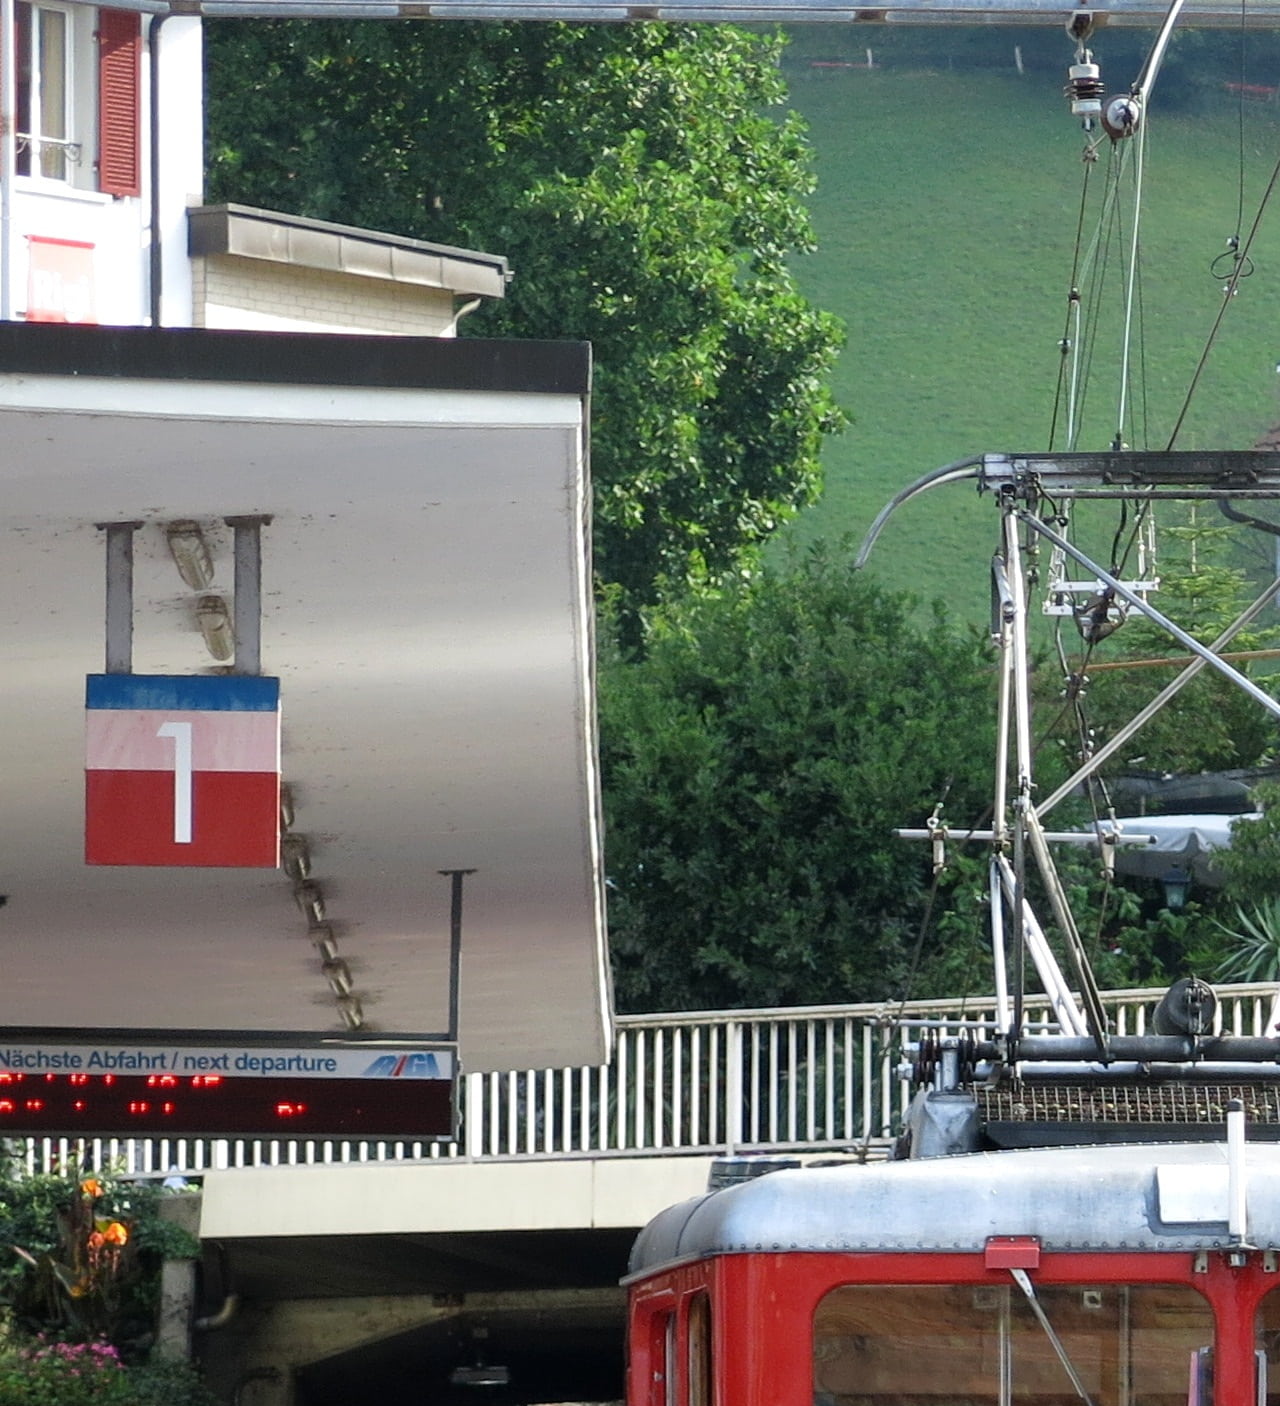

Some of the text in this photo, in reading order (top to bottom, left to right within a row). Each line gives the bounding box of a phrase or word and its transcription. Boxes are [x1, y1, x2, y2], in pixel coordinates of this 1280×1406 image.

[156, 721, 192, 843] 1
[0, 1050, 82, 1069] Nächste
[88, 1051, 166, 1070] Abfahrt
[184, 1054, 229, 1071] next
[235, 1053, 337, 1075] departure
